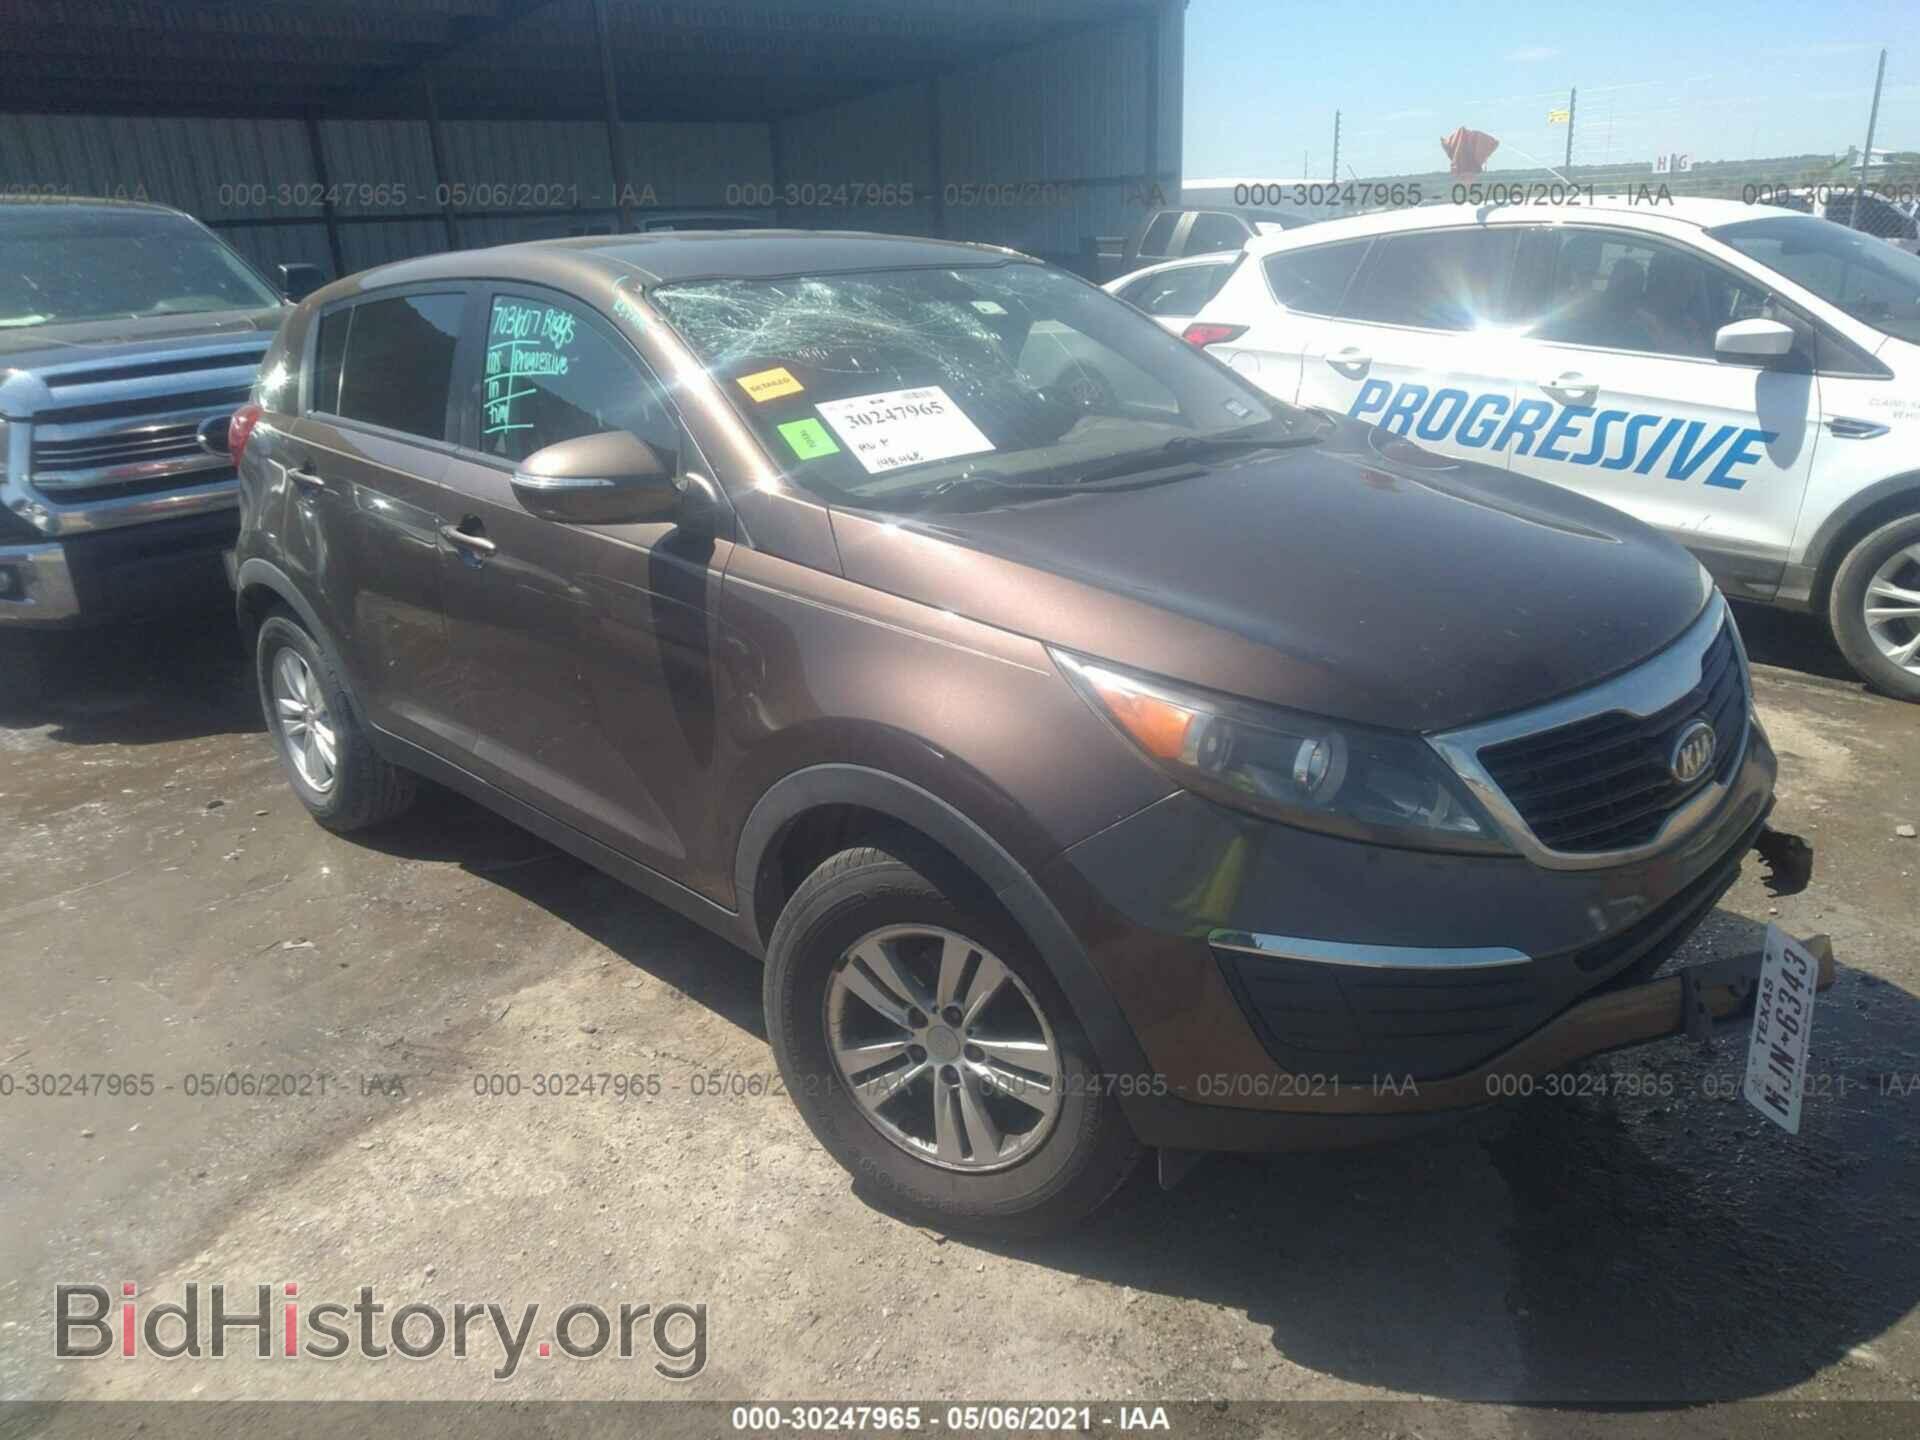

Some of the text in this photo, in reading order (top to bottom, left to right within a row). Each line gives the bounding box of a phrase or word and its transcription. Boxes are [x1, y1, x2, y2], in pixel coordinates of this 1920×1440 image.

[844, 401, 945, 429] 30247965
[1347, 378, 1780, 490] PROGRESSIVE
[1756, 976, 1775, 1046] TEXAS
